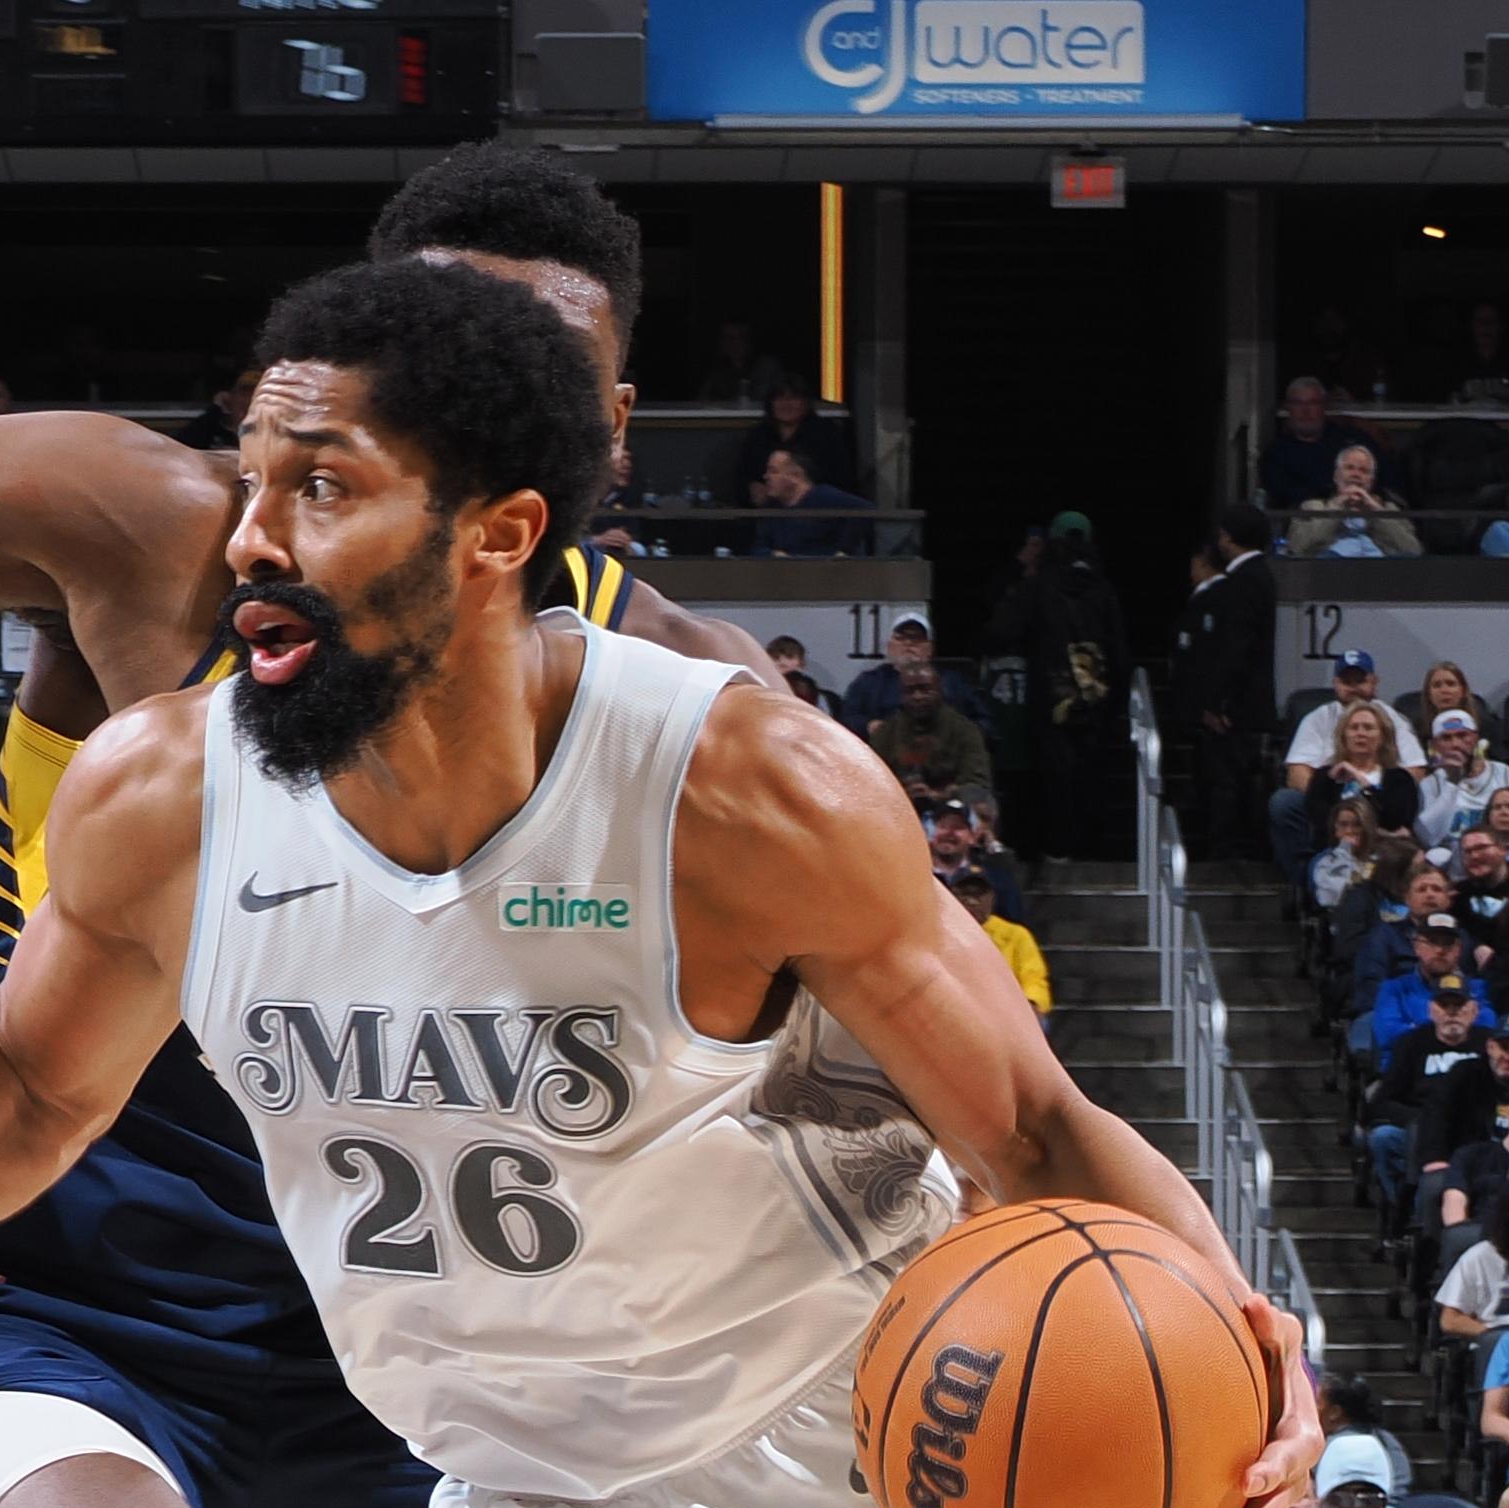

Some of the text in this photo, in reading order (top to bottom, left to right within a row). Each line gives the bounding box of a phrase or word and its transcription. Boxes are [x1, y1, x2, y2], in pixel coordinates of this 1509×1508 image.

[833, 26, 880, 50] and
[924, 9, 1135, 70] water
[1063, 166, 1115, 199] EXIT
[847, 604, 886, 660] 11
[1303, 605, 1343, 660] 12
[503, 886, 630, 929] chime
[233, 1000, 635, 1141] MAVS
[320, 1131, 584, 1278] 26
